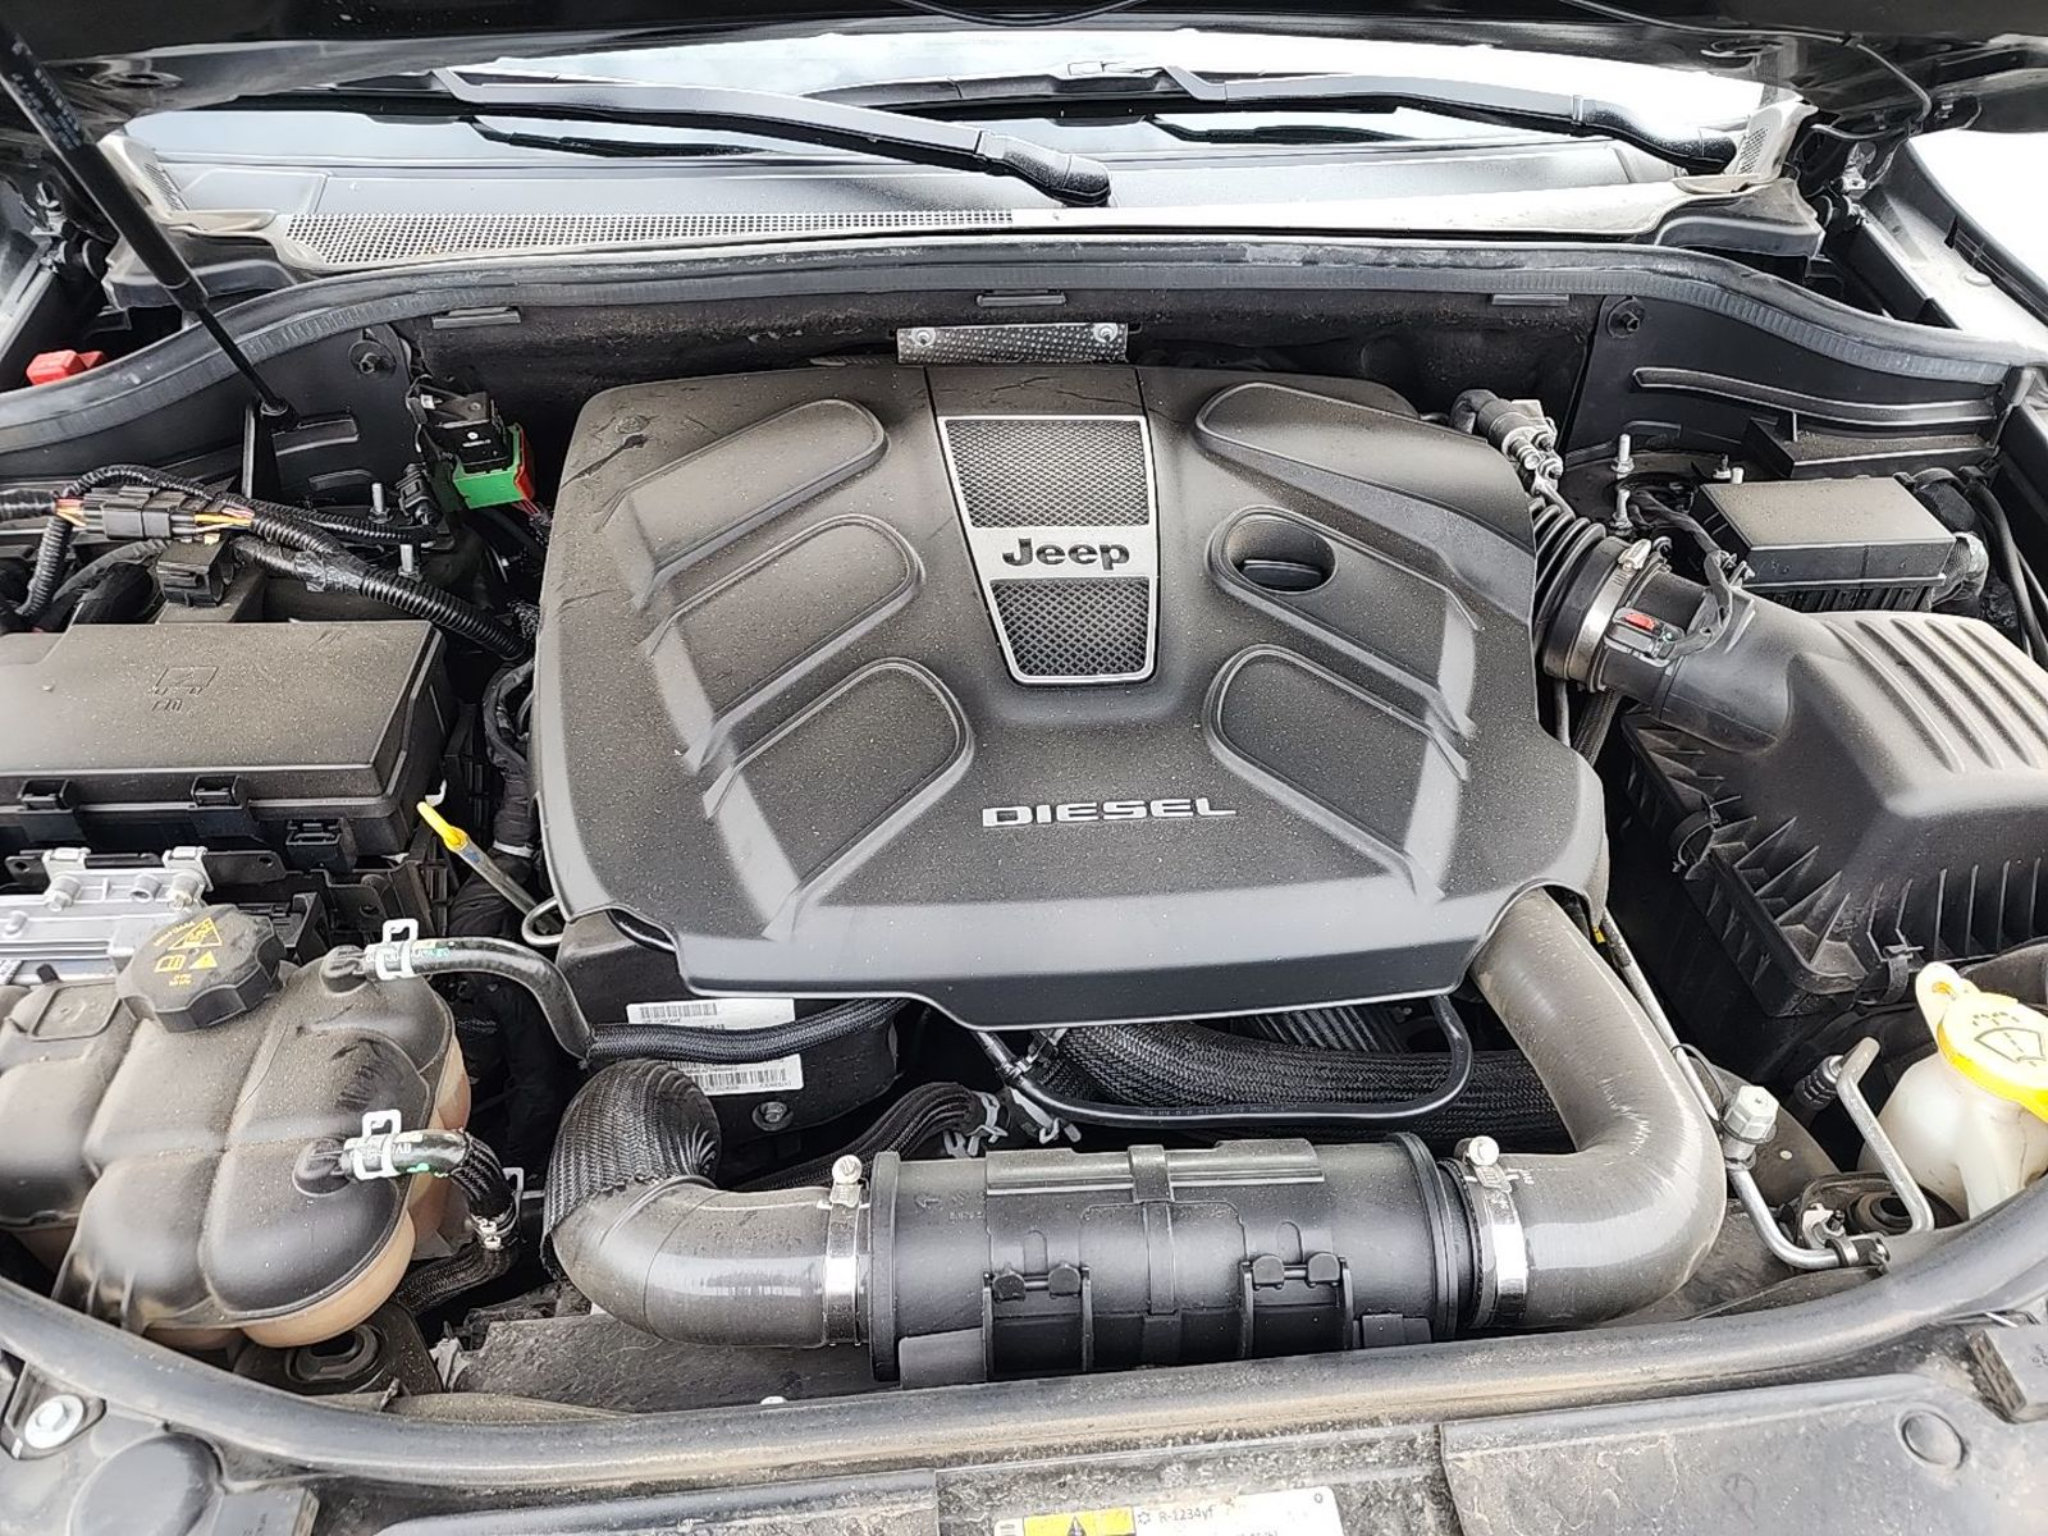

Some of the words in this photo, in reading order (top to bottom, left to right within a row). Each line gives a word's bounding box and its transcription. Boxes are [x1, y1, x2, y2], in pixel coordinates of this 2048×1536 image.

[1002, 538, 1130, 571] Jeep
[982, 798, 1237, 828] DIESEL
[1158, 1504, 1216, 1523] R-1234yf
